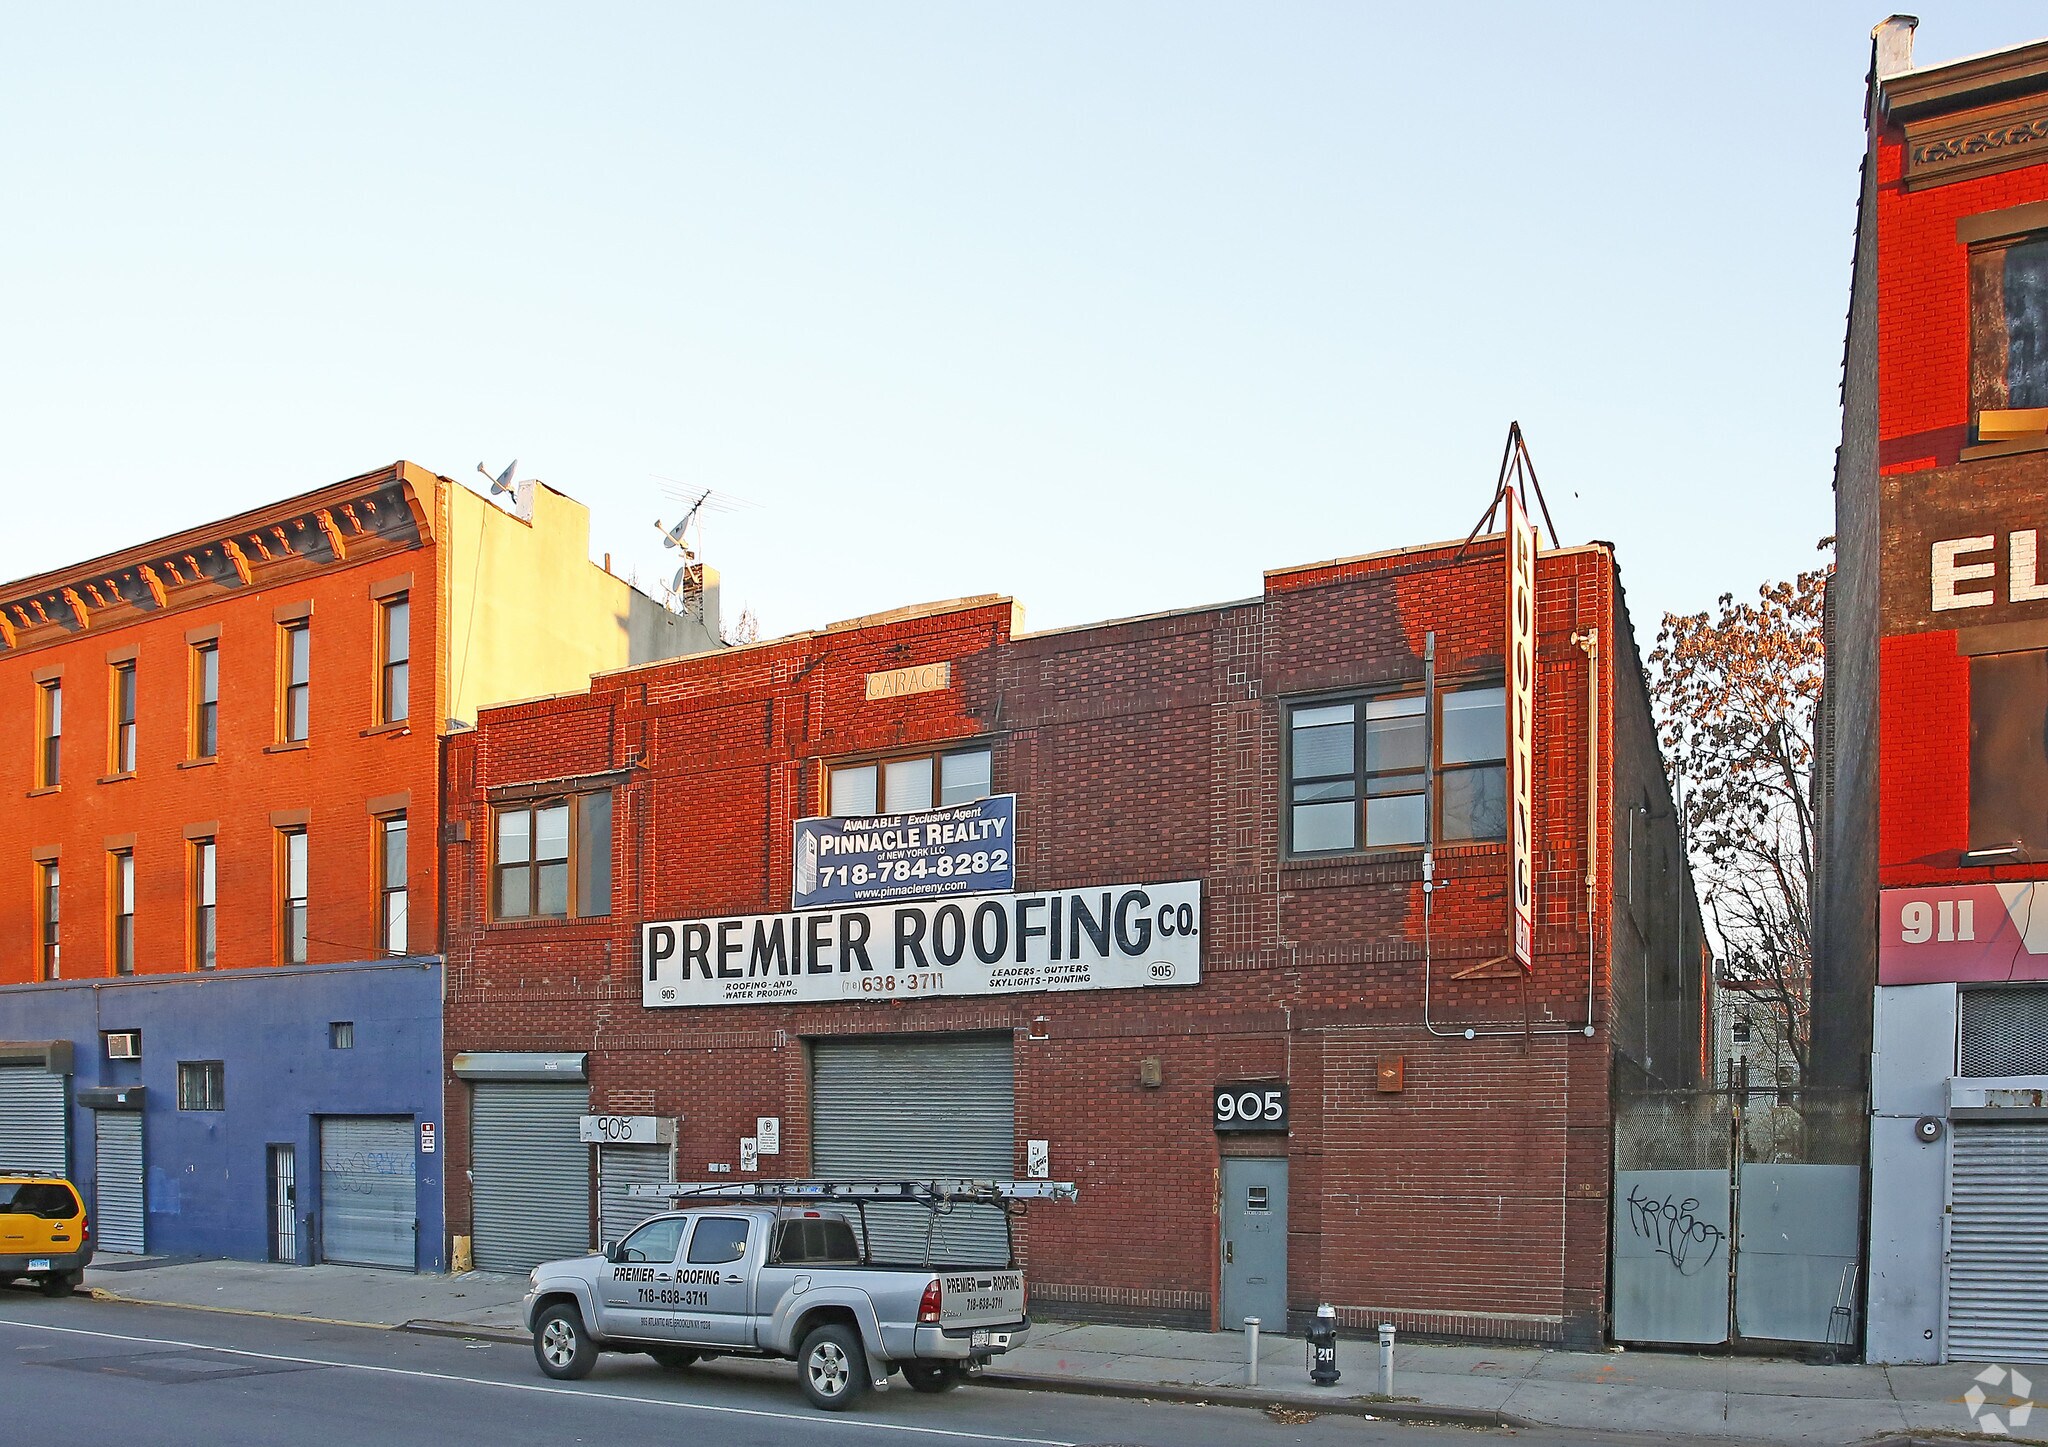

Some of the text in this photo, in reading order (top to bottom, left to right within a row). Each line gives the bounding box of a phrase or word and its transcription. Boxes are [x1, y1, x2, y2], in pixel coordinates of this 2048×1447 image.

[1516, 525, 1529, 907] ROOFING
[843, 806, 982, 833] AVAILABLE Exclusive Agent
[820, 817, 1007, 856] PINNACLE REALTY
[877, 845, 946, 861] of NEW YORK LLC
[819, 849, 1009, 888] 718-784-8282
[854, 879, 967, 900] www.pinnaclereny.com
[1901, 900, 1975, 944] 911
[648, 890, 1199, 982] PREMIER ROOFING CO.
[1044, 964, 1090, 975] GUTTERS
[1150, 965, 1172, 977] 905
[661, 988, 675, 1000] 905
[725, 988, 798, 999] WATER PROOFING
[1217, 1091, 1283, 1121] 905
[598, 1116, 633, 1140] 905
[1212, 1168, 1220, 1215] RING
[614, 1267, 720, 1286] PREMIER ROOFING
[946, 1275, 1020, 1294] PREMIER ROOFING
[638, 1288, 708, 1306] 718-638-3711
